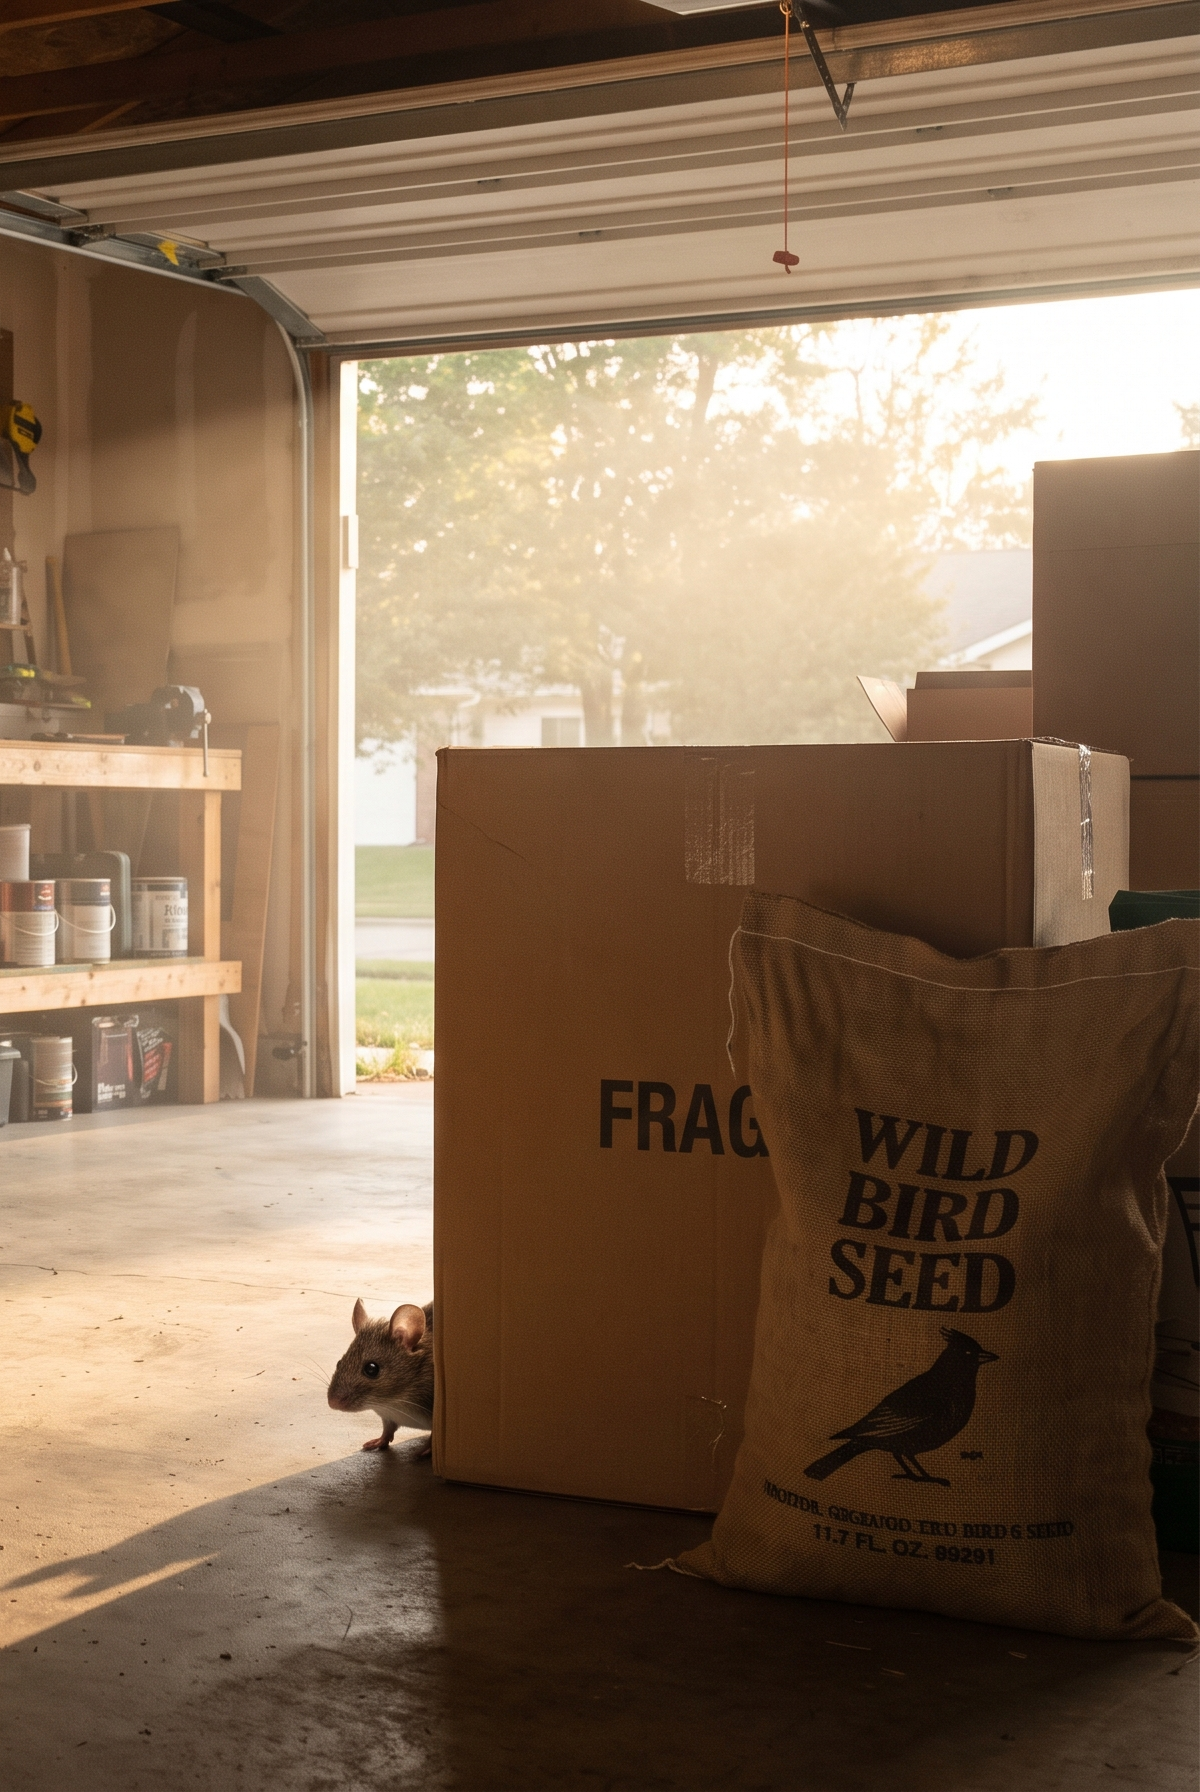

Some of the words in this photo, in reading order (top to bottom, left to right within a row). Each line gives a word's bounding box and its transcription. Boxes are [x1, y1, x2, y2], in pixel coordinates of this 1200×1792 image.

[854, 1107, 1039, 1182] WILD
[838, 1170, 1020, 1242] BIRD
[829, 1238, 1016, 1313] SEED
[812, 1523, 849, 1547] 11.7
[855, 1532, 887, 1554] FL.
[892, 1538, 928, 1559] OZ.
[963, 1523, 1007, 1539] BIRD
